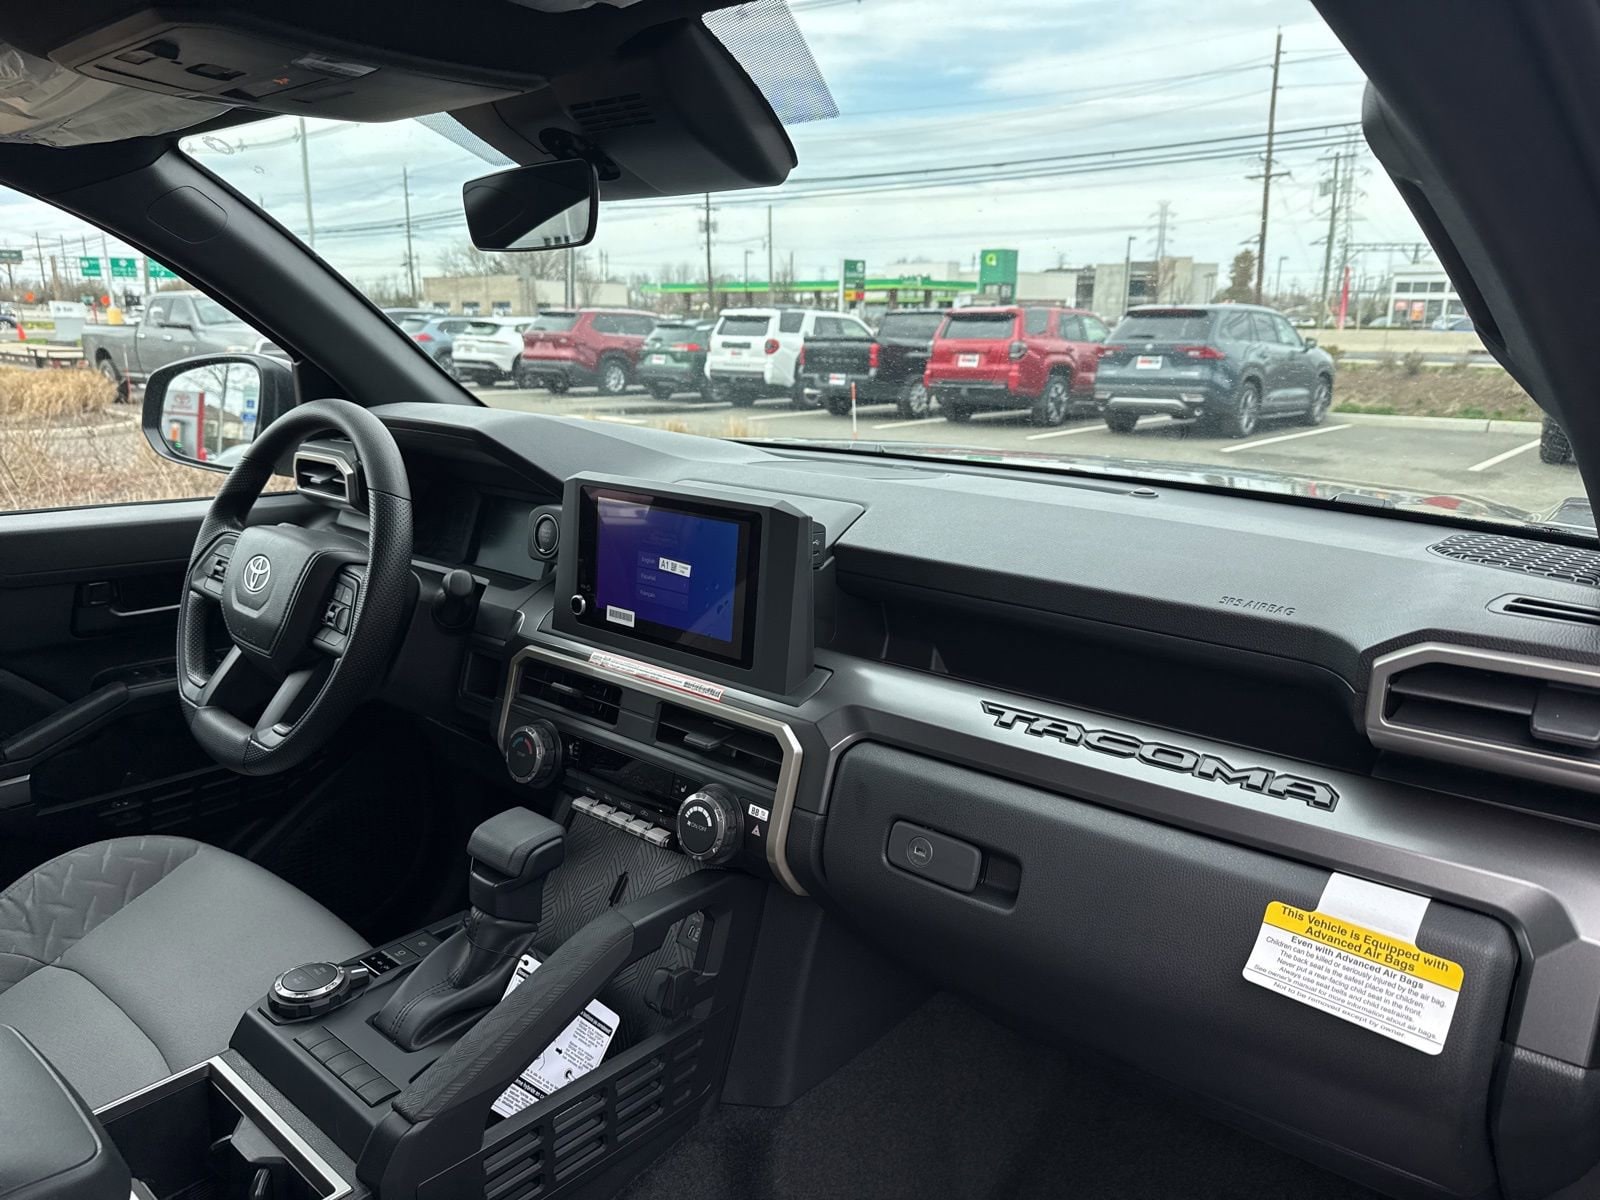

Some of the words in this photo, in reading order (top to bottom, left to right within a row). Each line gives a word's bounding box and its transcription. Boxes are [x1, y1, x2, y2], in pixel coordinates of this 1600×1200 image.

[1219, 596, 1243, 606] SRS
[1243, 600, 1296, 616] AIRBAG
[981, 700, 1340, 812] TACOMA
[1280, 906, 1304, 920] This
[1307, 916, 1348, 935] Vehicle
[1350, 931, 1360, 940] is
[1363, 935, 1420, 963] Equipped
[1423, 956, 1449, 971] with
[1291, 936, 1313, 948] Even
[1315, 944, 1334, 956] with
[1336, 952, 1381, 973] Advanced
[1383, 969, 1397, 979] Air
[1399, 975, 1424, 990] Bags
[1305, 926, 1361, 952] Advanced
[1364, 947, 1382, 959] Air
[1384, 954, 1416, 973] Bags
[1266, 936, 1292, 950] Children
[1292, 947, 1304, 955] can
[1316, 954, 1333, 965] killed
[1341, 964, 1372, 981] seriously
[1372, 975, 1396, 990] injured
[1407, 988, 1419, 997] the
[1420, 992, 1430, 1001] air
[1431, 996, 1447, 1008] bag.
[1277, 957, 1296, 968] Never
[1296, 965, 1307, 973] put
[1314, 971, 1349, 989] rear-facing
[1350, 985, 1366, 995] child
[1367, 992, 1383, 1001] seat
[1392, 1001, 1403, 1009] the
[1279, 966, 1301, 979] Always
[1316, 980, 1330, 989] seat
[1331, 986, 1347, 996] belts
[1349, 993, 1362, 1002] and
[1363, 998, 1379, 1008] child
[1280, 950, 1292, 958] The
[1293, 955, 1308, 964] back
[1310, 961, 1324, 970] seat
[1332, 969, 1343, 977] the
[1344, 974, 1364, 985] safest
[1365, 981, 1384, 994] place
[1385, 989, 1394, 997] for
